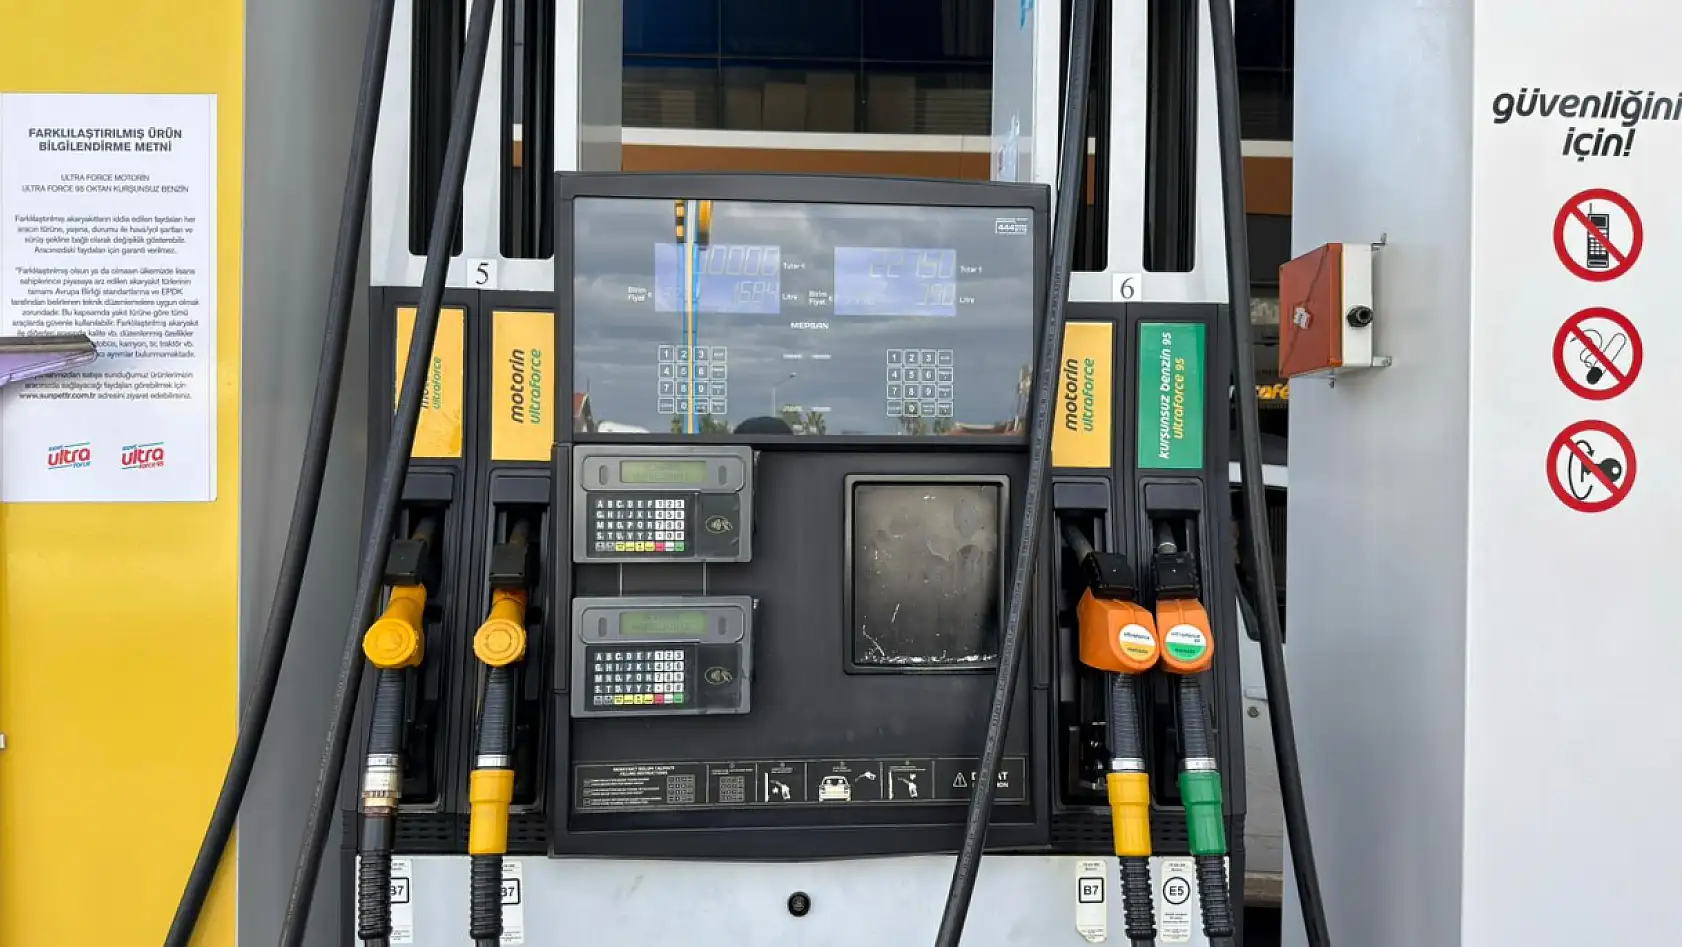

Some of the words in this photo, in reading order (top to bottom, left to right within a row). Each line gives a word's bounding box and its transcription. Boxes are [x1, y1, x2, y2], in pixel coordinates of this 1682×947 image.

[29, 126, 145, 141] FARKLILAŞTIRILMIŞ
[147, 125, 183, 139] ÜRÜN
[1562, 126, 1636, 162] için!
[39, 140, 132, 152] BİLGİLENDİRME
[135, 140, 172, 152] METNİ
[61, 173, 85, 182] ULTRA
[86, 173, 113, 182] FORCE
[22, 184, 46, 193] ULTRA
[47, 184, 73, 193] FORCE
[75, 184, 84, 193] 95
[86, 184, 112, 193] OKTAN
[113, 184, 160, 195] KURŞUNSUZ
[161, 184, 188, 193] BENZİN
[476, 262, 489, 285] 5
[1120, 277, 1134, 299] 6
[1162, 332, 1172, 346] 95
[1159, 348, 1172, 392] benzin
[1174, 357, 1185, 371] 95
[432, 356, 442, 410] ultraforce
[509, 348, 526, 424] motorin
[528, 348, 542, 425] ultraforce
[1064, 358, 1079, 432] motorin
[1082, 357, 1095, 432] ultraforce
[1173, 374, 1184, 440] ultraforce
[1158, 394, 1171, 460] kurşunsuz
[48, 447, 91, 466] ultra
[121, 447, 164, 466] ultra
[1083, 885, 1099, 897] B7
[1169, 885, 1185, 897] E5
